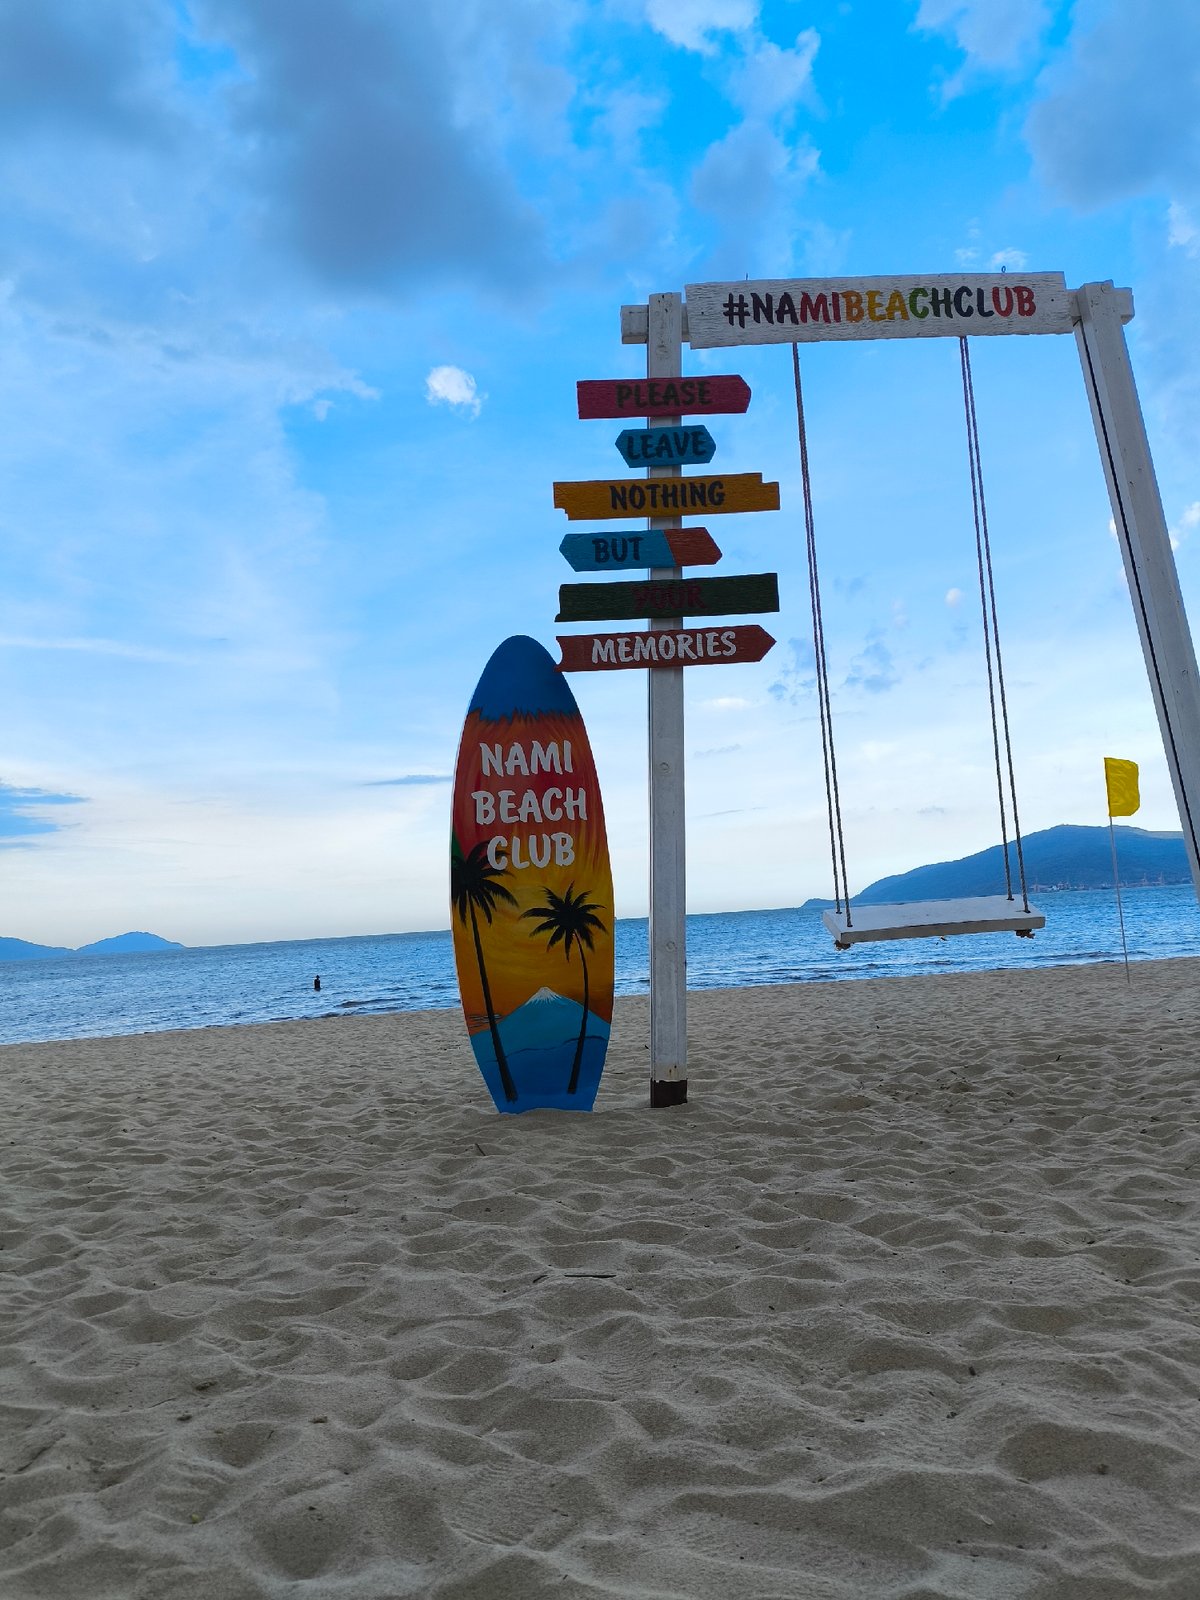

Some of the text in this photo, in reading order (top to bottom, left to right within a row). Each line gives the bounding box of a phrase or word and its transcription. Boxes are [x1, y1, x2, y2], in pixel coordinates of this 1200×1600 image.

[722, 285, 1037, 328] #NAMIBEACHCLUB
[615, 380, 713, 408] PLEASE
[626, 430, 709, 460] LEAVE
[609, 480, 726, 511] NOTHING
[591, 536, 644, 563] BUT
[631, 584, 706, 612] YOUR
[591, 631, 737, 664] MEMORIES
[479, 740, 574, 777] NAMI
[471, 786, 588, 825] BEACH
[486, 831, 576, 871] CLUB
